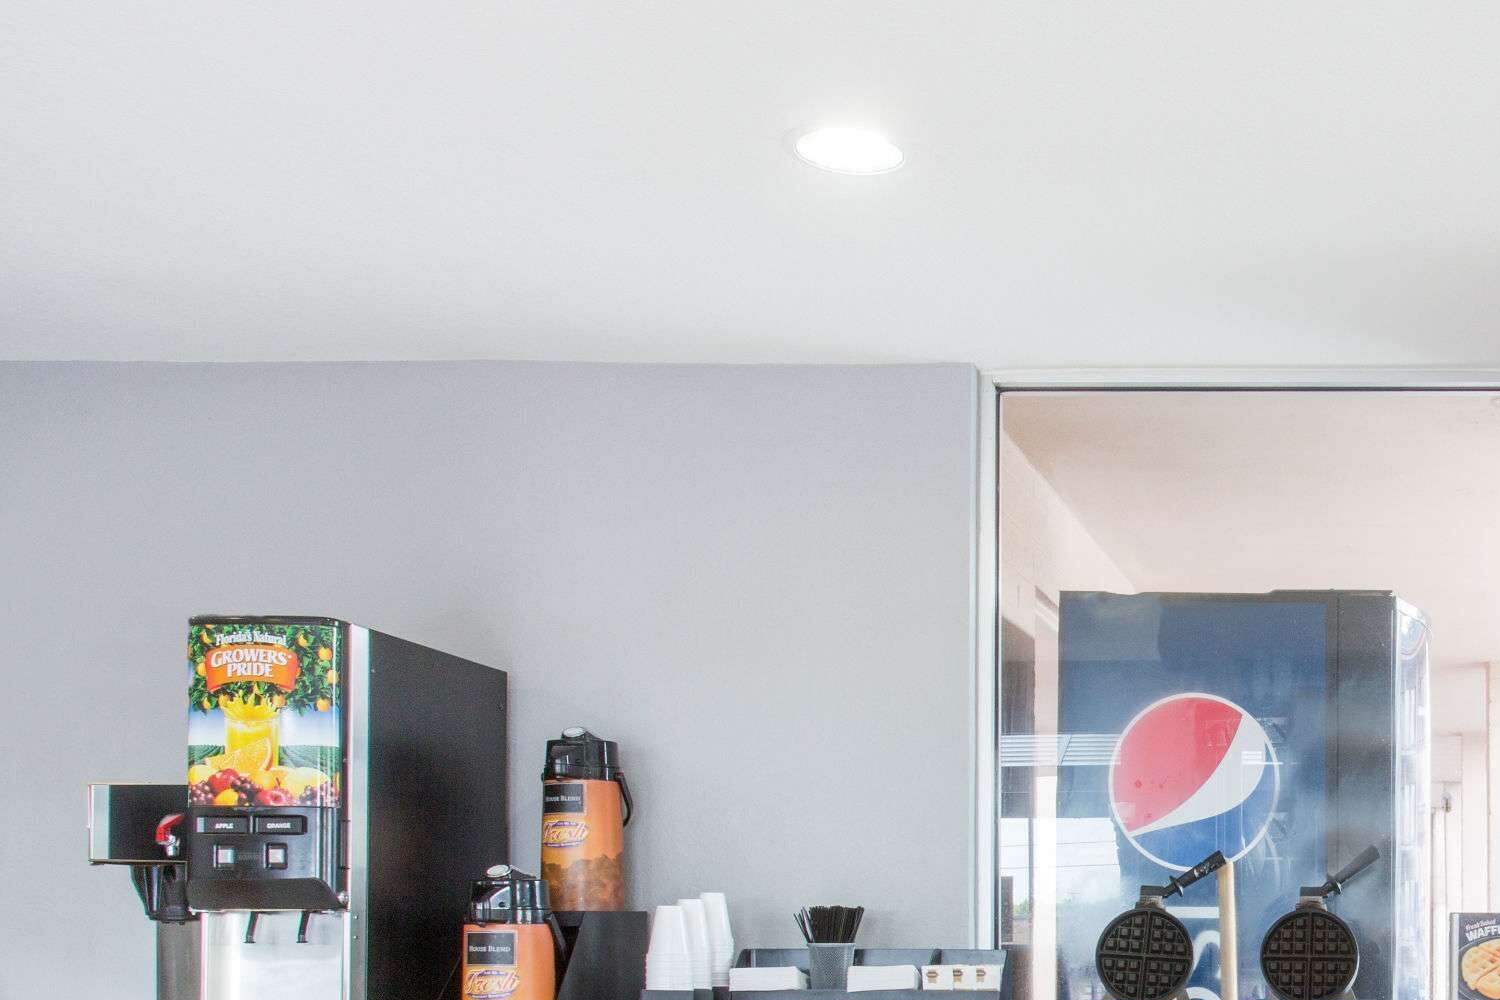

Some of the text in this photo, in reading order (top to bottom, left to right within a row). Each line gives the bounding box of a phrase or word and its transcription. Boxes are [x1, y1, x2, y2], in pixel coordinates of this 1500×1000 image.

[253, 631, 288, 647] Natural
[227, 662, 273, 677] PRIDE
[488, 944, 511, 953] BLEND
